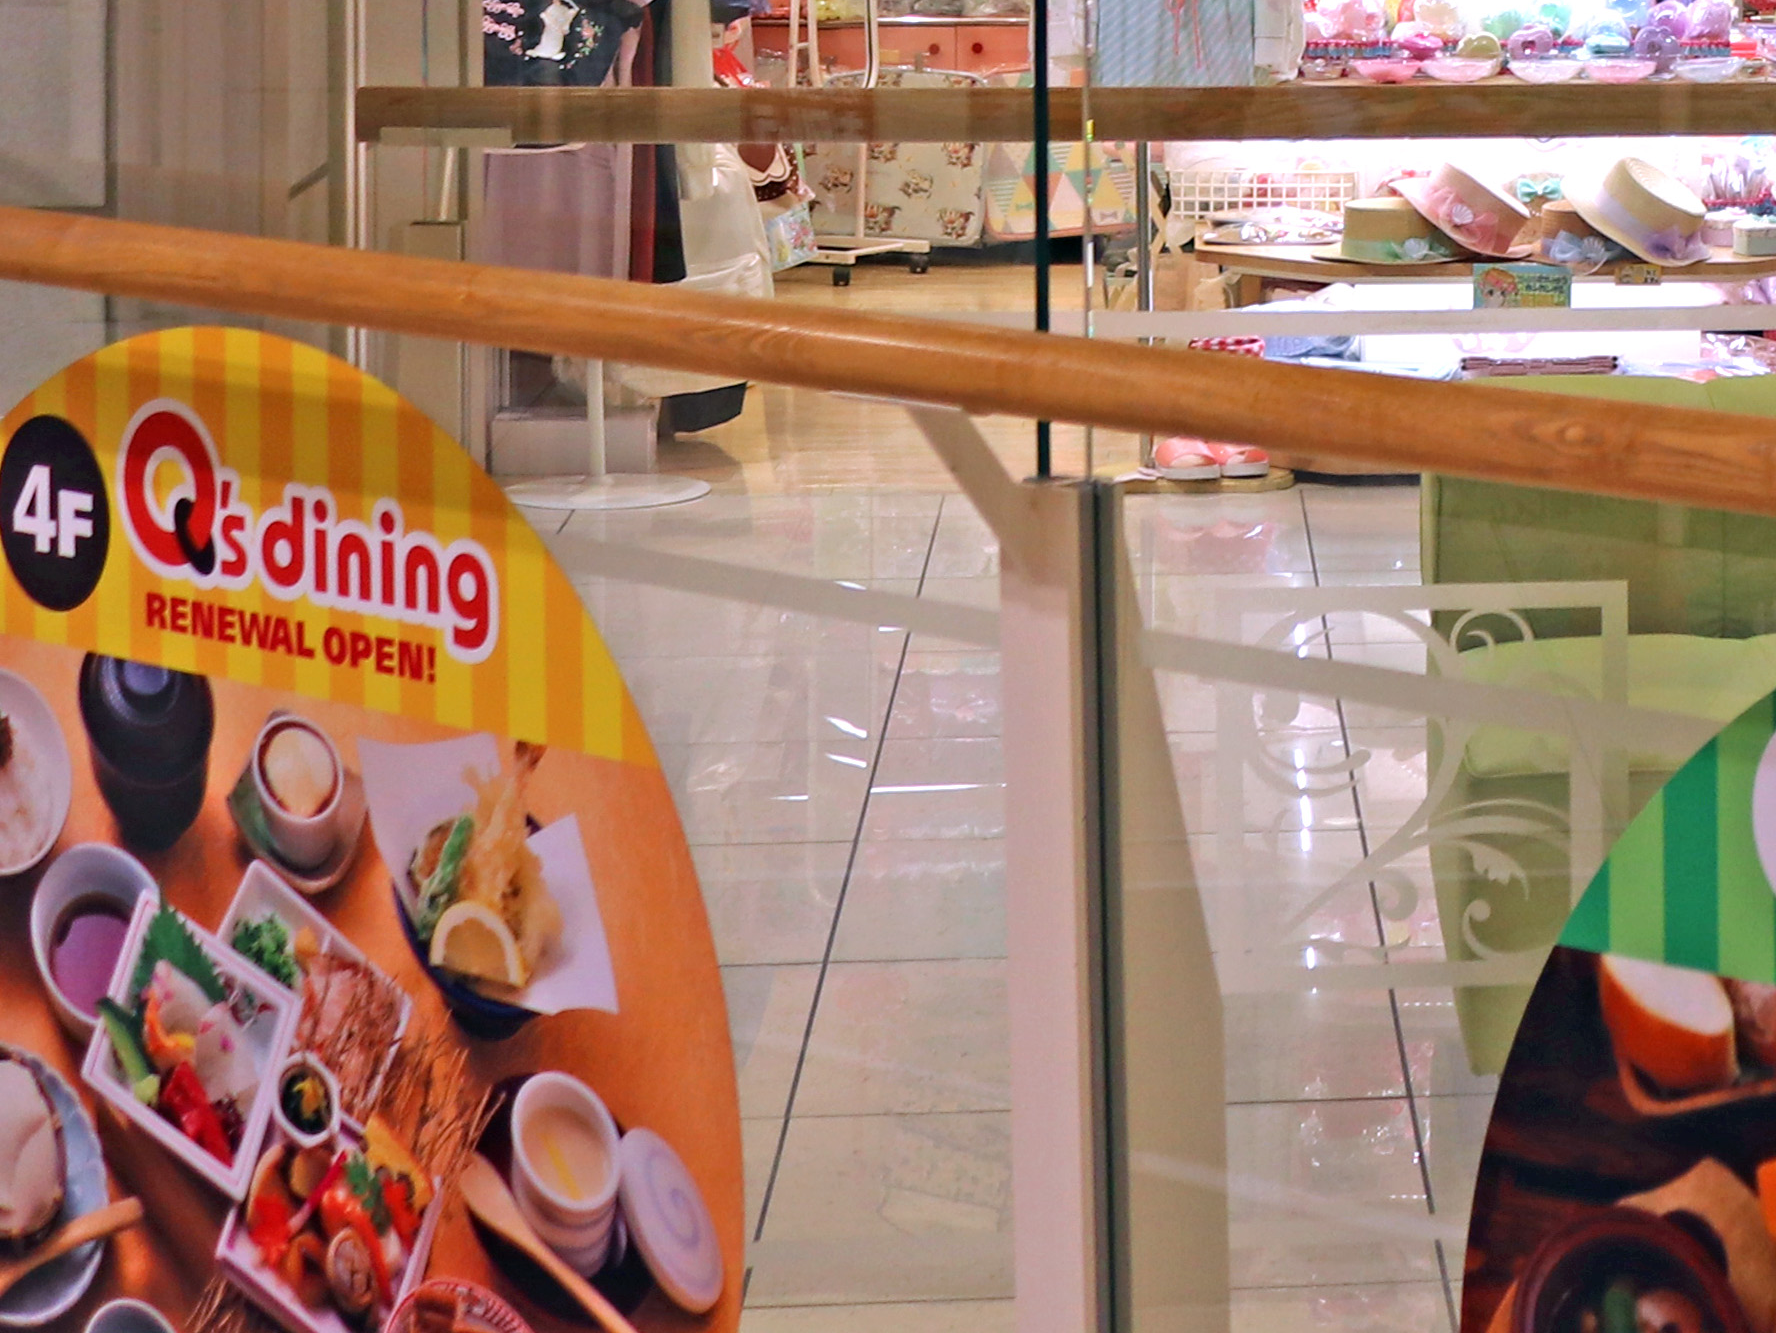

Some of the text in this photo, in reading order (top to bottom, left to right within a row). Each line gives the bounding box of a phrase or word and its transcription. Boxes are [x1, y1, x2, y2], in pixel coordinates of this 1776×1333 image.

[12, 408, 493, 650] 4F Q's dining
[145, 590, 437, 683] RENEWAL OPEN!
